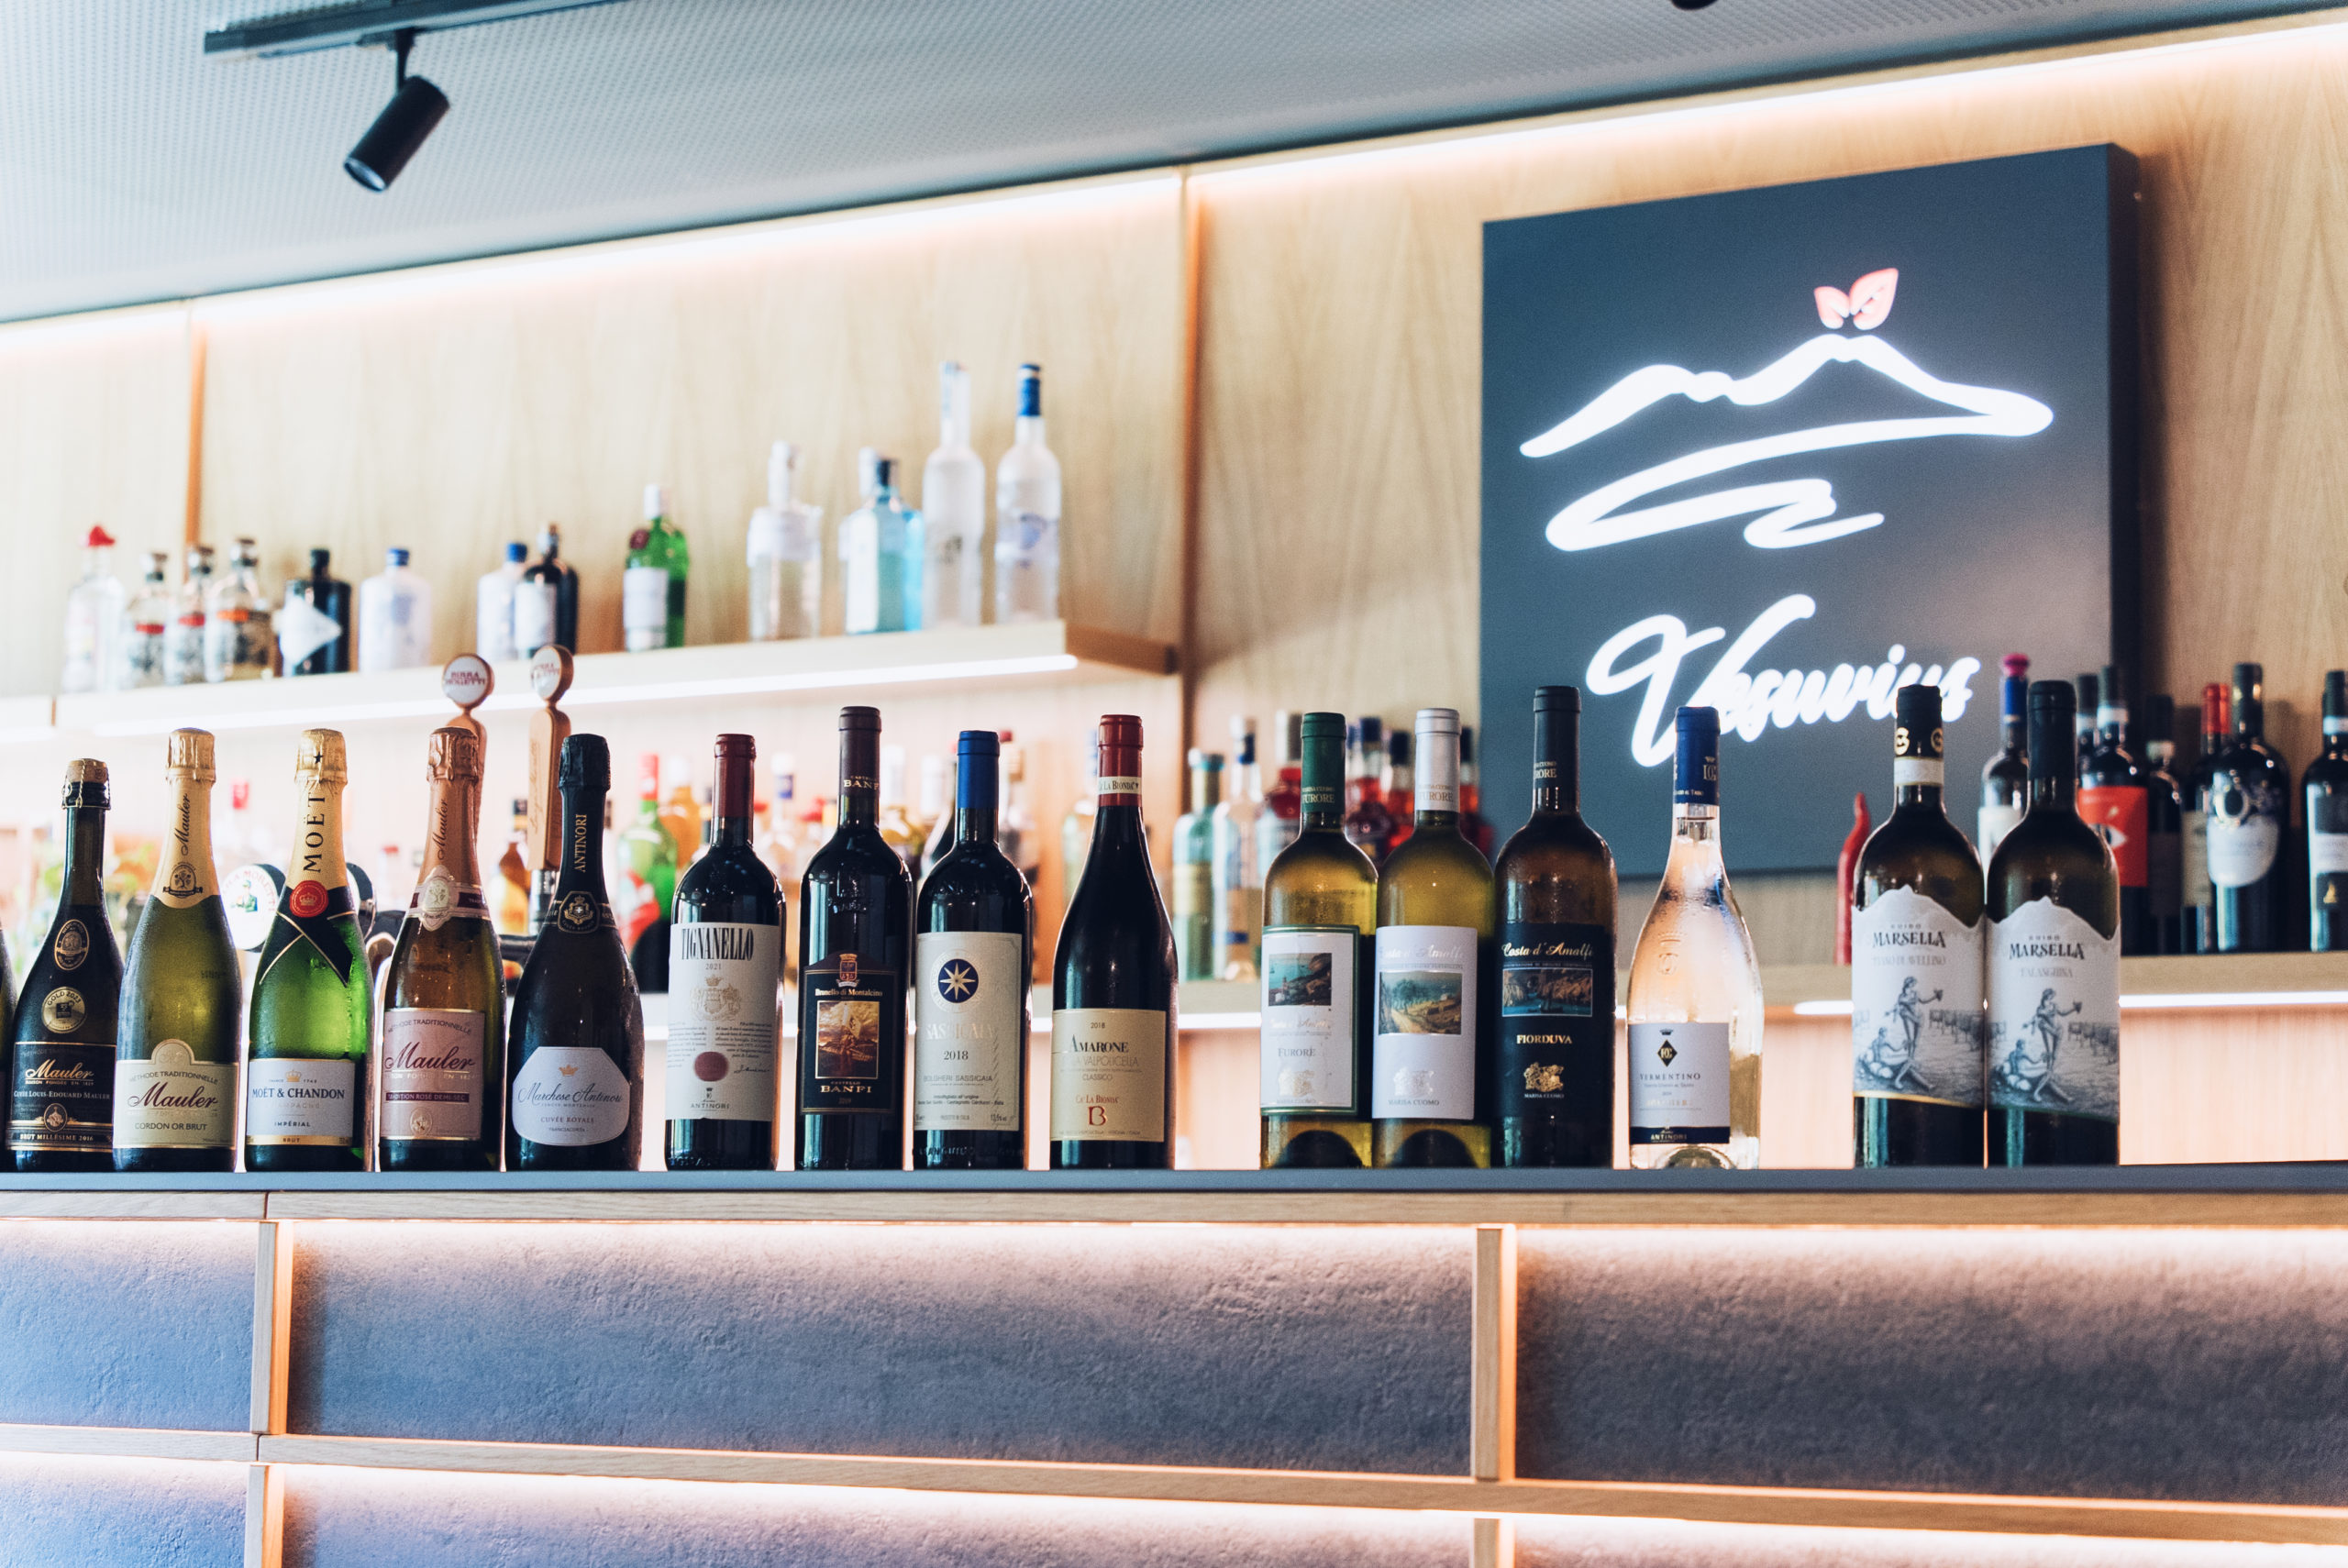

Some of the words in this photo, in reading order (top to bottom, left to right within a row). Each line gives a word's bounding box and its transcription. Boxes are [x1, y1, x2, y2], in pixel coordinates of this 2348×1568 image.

[1534, 768, 1557, 779] RORE
[843, 779, 880, 790] BANF
[174, 793, 191, 856] Mauler
[303, 792, 326, 873] MOËT
[432, 799, 449, 860] Mauler
[574, 813, 587, 873] ANTINORI
[681, 927, 755, 961] TIGNANELLO
[1872, 931, 1946, 949] MARSELLA
[1501, 942, 1530, 956] Costa
[2009, 943, 2086, 961] MARSELLA
[47, 991, 65, 1006] GOLD
[847, 988, 882, 997] Montalcino
[388, 1020, 412, 1033] MODE
[413, 1019, 472, 1035] TRADITIONNELLE
[926, 1022, 997, 1040] SASICAIA
[1070, 1034, 1129, 1053] AMARONE
[1516, 1034, 1572, 1044] FIORDUVA
[384, 1041, 477, 1070] Mauler
[943, 1050, 969, 1061] 2018
[1278, 1048, 1316, 1057] FURORE
[25, 1058, 95, 1079] Mauler
[160, 1070, 220, 1085] TRADITIONNELLE
[1639, 1073, 1701, 1081] VERMENTINO
[127, 1081, 219, 1109] Mauler
[252, 1087, 275, 1099] MOËT
[276, 1088, 285, 1099] &
[286, 1088, 346, 1099] CHANDON
[517, 1082, 570, 1106] Marchese
[571, 1082, 624, 1103] Antinori
[820, 1085, 873, 1094] BANFI
[135, 1122, 170, 1131] CORDON
[185, 1123, 208, 1132] BRUT
